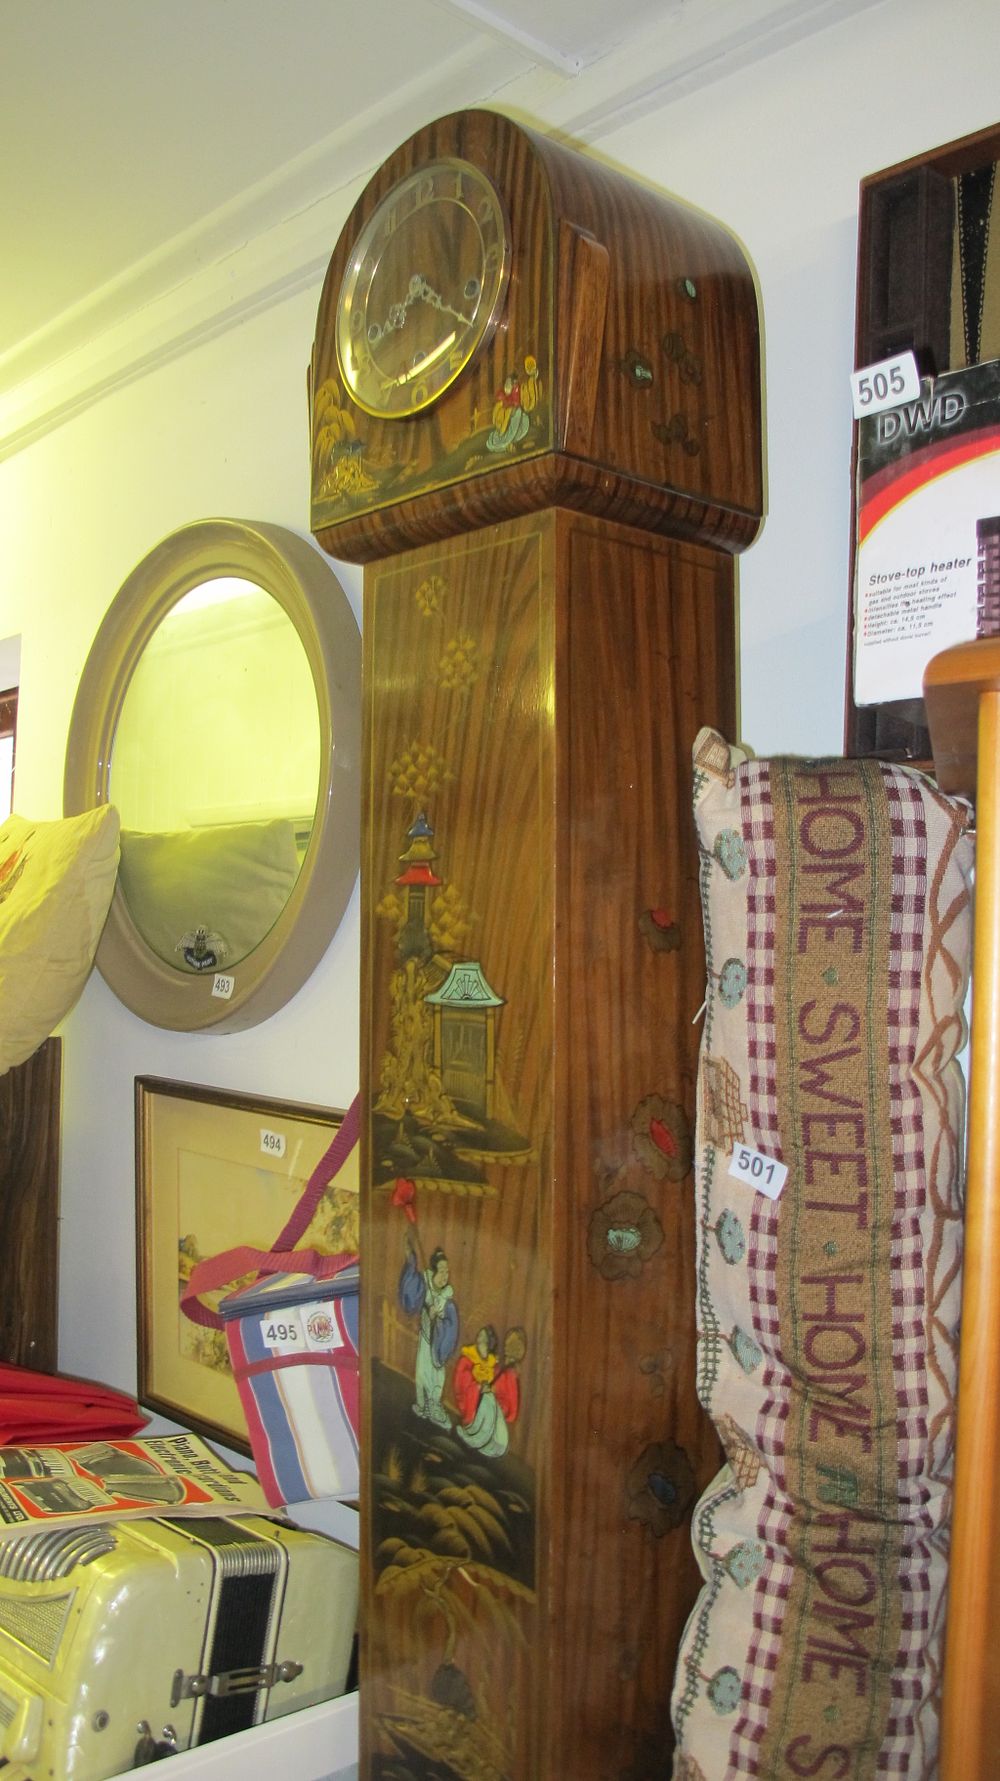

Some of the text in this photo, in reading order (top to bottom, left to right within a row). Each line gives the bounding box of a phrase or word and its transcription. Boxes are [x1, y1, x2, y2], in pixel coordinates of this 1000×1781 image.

[411, 377, 429, 407] 6
[858, 366, 905, 406] 505
[879, 392, 966, 443] DWD
[869, 558, 972, 586] Stove-top heater
[215, 978, 230, 993] 493
[795, 772, 872, 1454] HOME SWEET HOME
[263, 1133, 281, 1152] 494
[738, 1149, 775, 1185] 501
[266, 1324, 298, 1341] 495
[167, 1436, 199, 1461] Piano,
[802, 1511, 878, 1697] HOME
